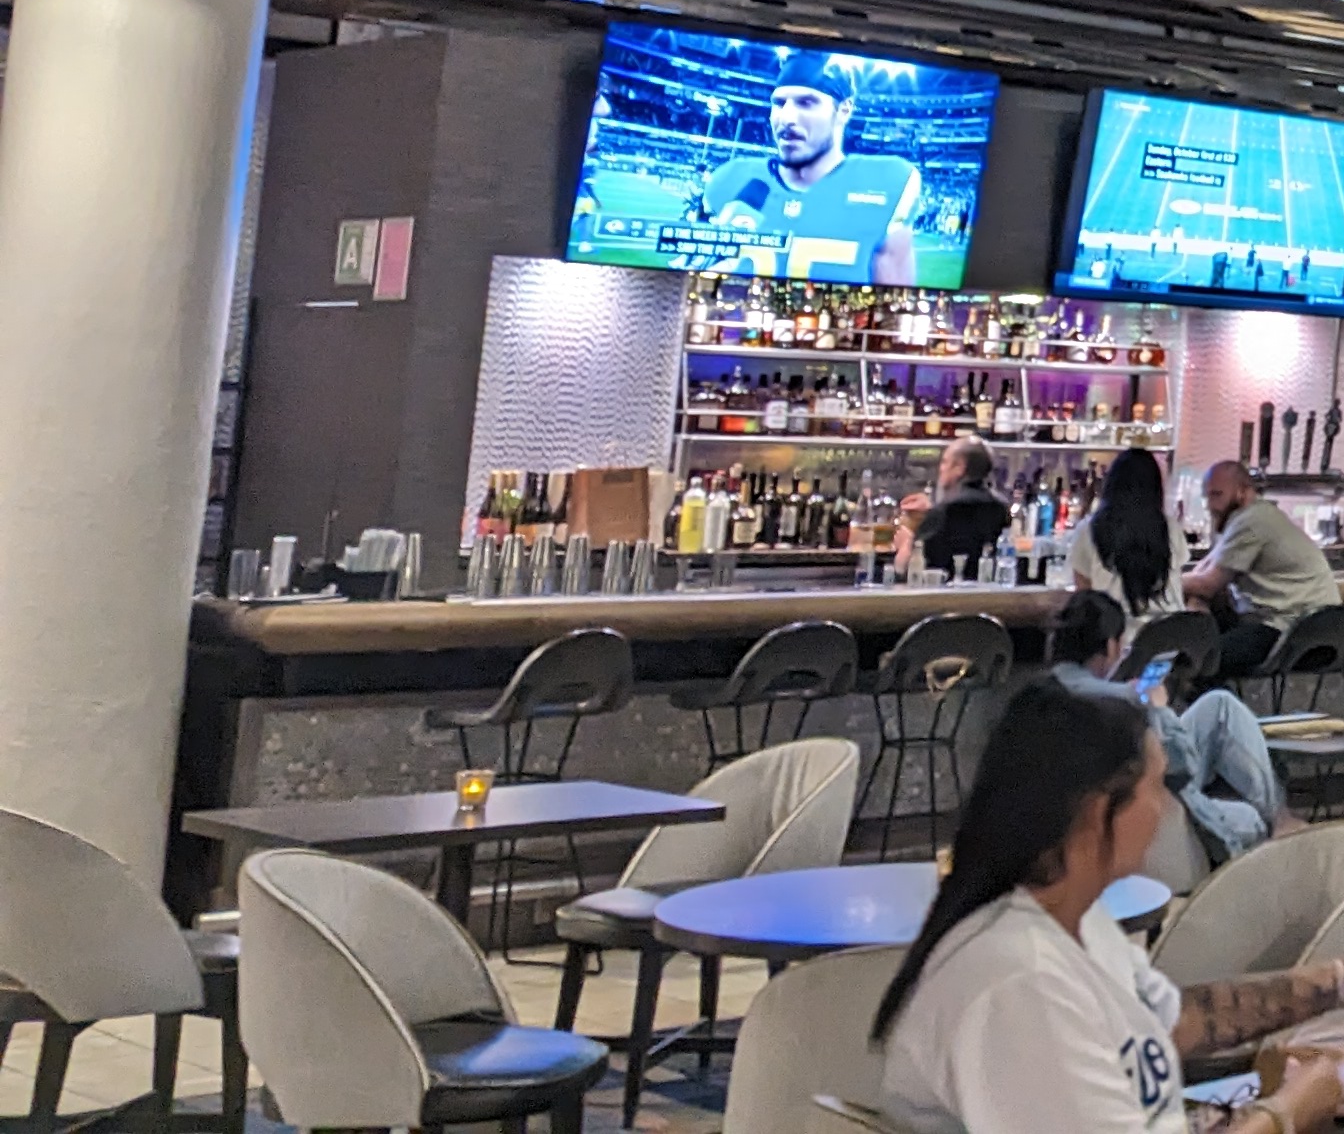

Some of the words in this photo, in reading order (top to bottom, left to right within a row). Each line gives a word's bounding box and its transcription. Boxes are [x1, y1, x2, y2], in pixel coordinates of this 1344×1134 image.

[675, 227, 692, 239] THE
[692, 229, 718, 241] WEEK
[342, 237, 357, 269] A
